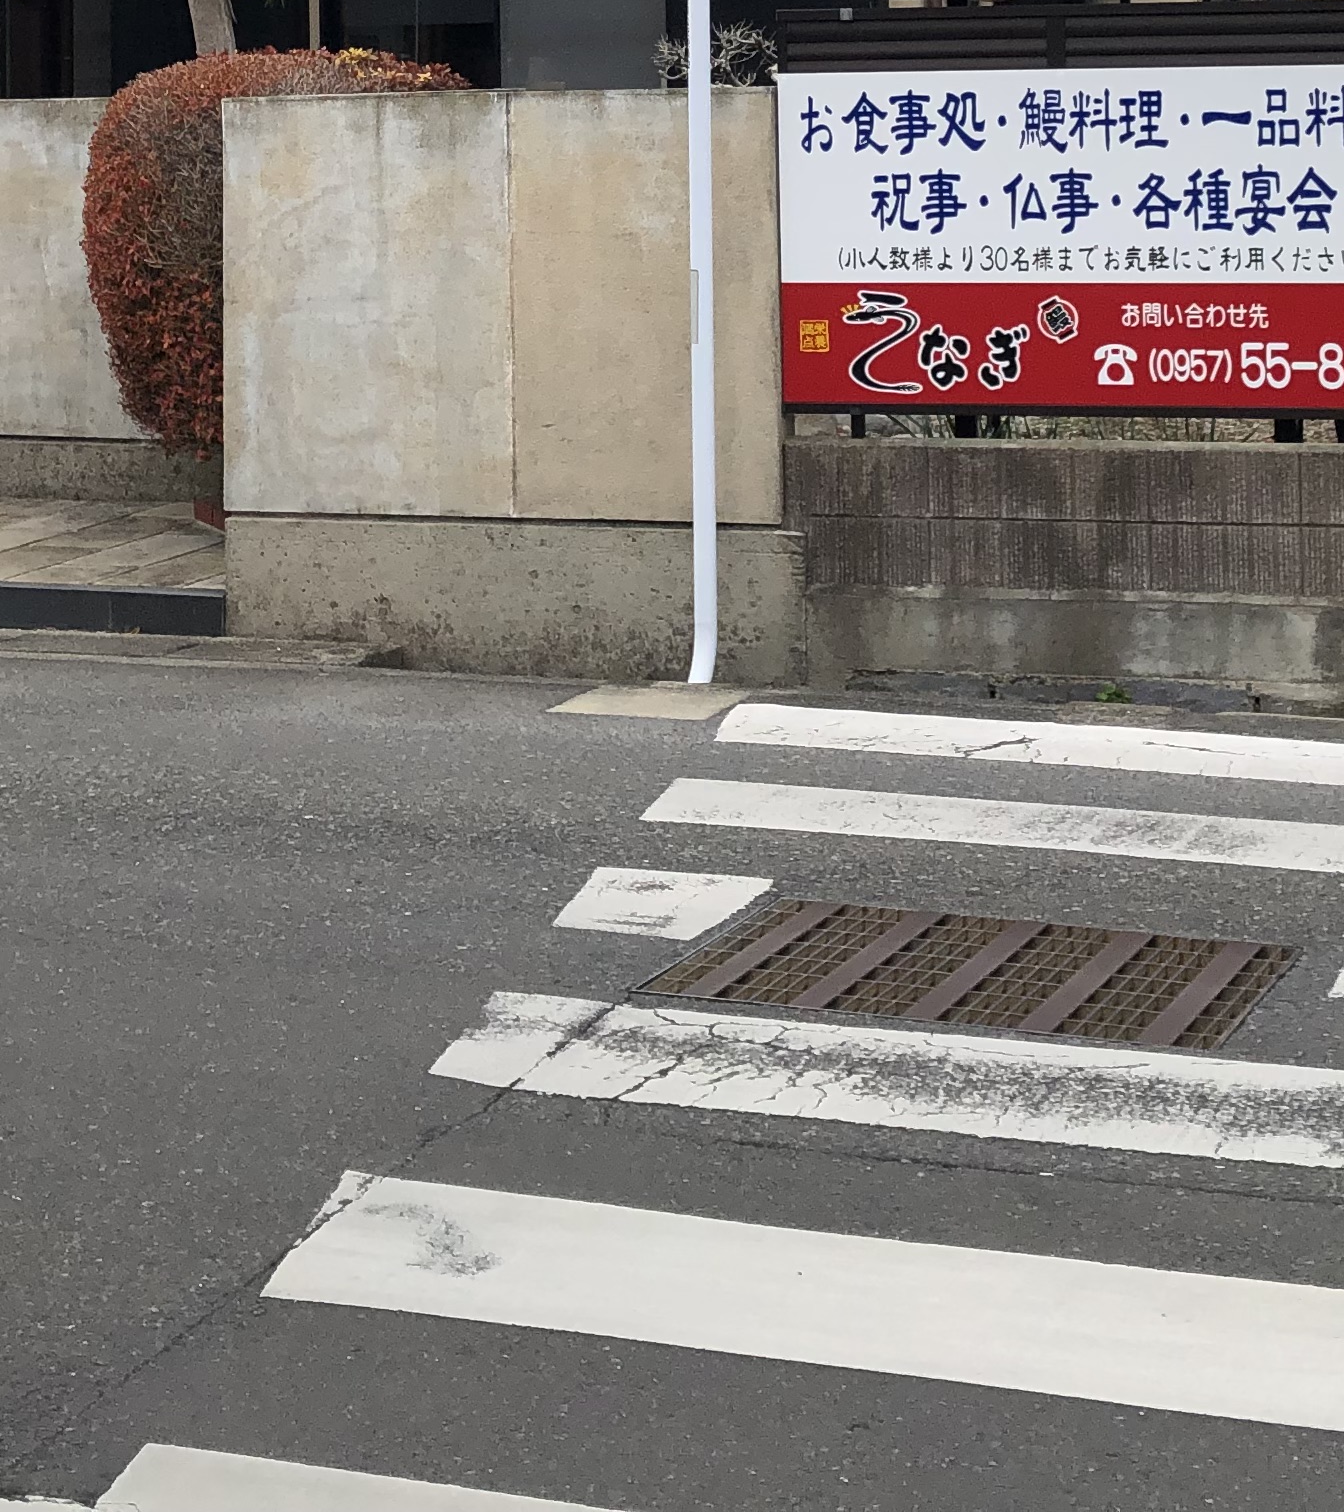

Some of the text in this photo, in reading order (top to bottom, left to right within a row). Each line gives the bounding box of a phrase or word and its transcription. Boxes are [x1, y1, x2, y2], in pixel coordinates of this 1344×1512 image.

[871, 164, 1338, 236] 祝事・仏事・各種宴会
[842, 290, 1030, 394] うなぎ
[1120, 302, 1270, 329] お問い合わせ先
[1149, 348, 1233, 384] (0957)
